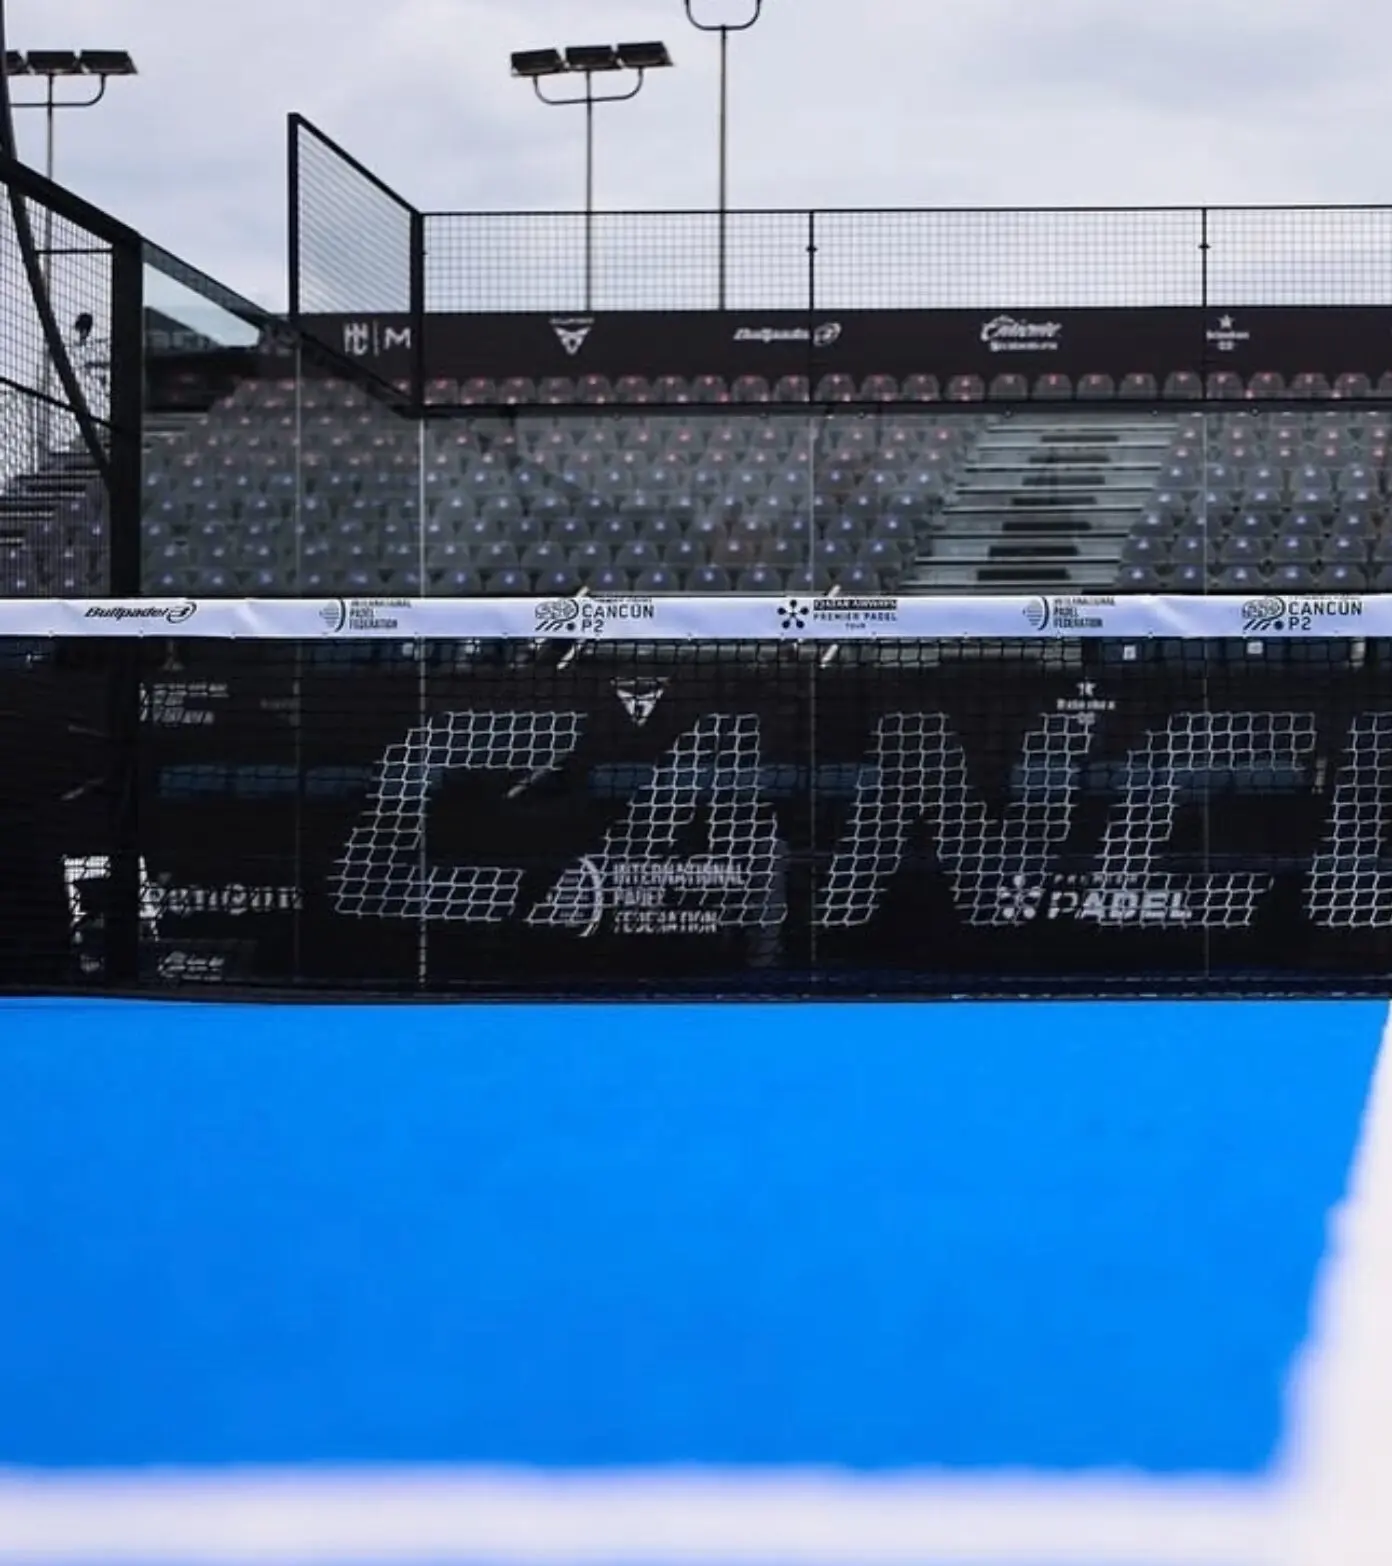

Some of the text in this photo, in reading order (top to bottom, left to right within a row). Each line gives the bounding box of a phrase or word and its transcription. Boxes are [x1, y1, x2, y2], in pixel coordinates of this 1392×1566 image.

[581, 619, 605, 633] P2
[1288, 617, 1312, 631] P2
[1048, 891, 1192, 920] PADEL
